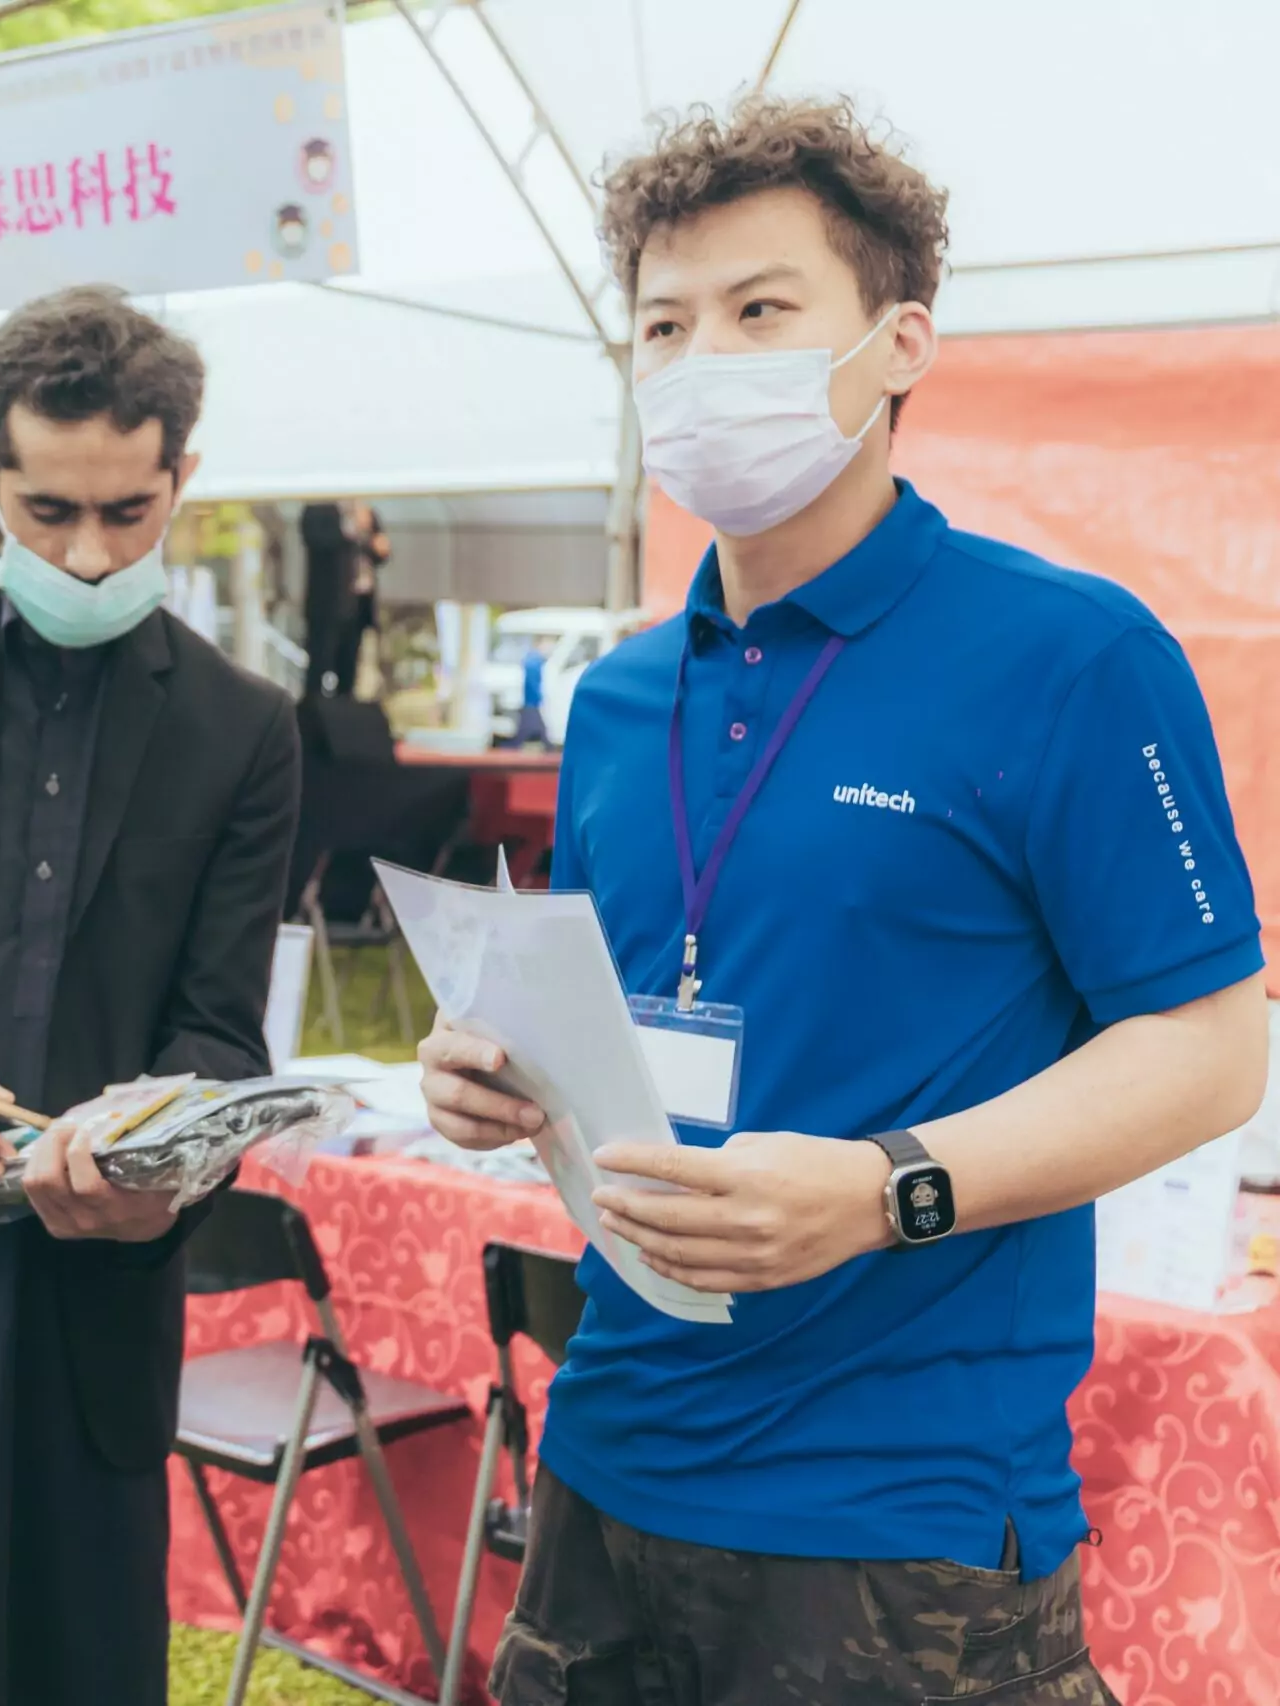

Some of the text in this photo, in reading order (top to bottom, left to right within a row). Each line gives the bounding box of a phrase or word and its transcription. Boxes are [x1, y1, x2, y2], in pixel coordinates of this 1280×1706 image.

[832, 782, 916, 814] unitech
[1141, 742, 1215, 925] because we care
